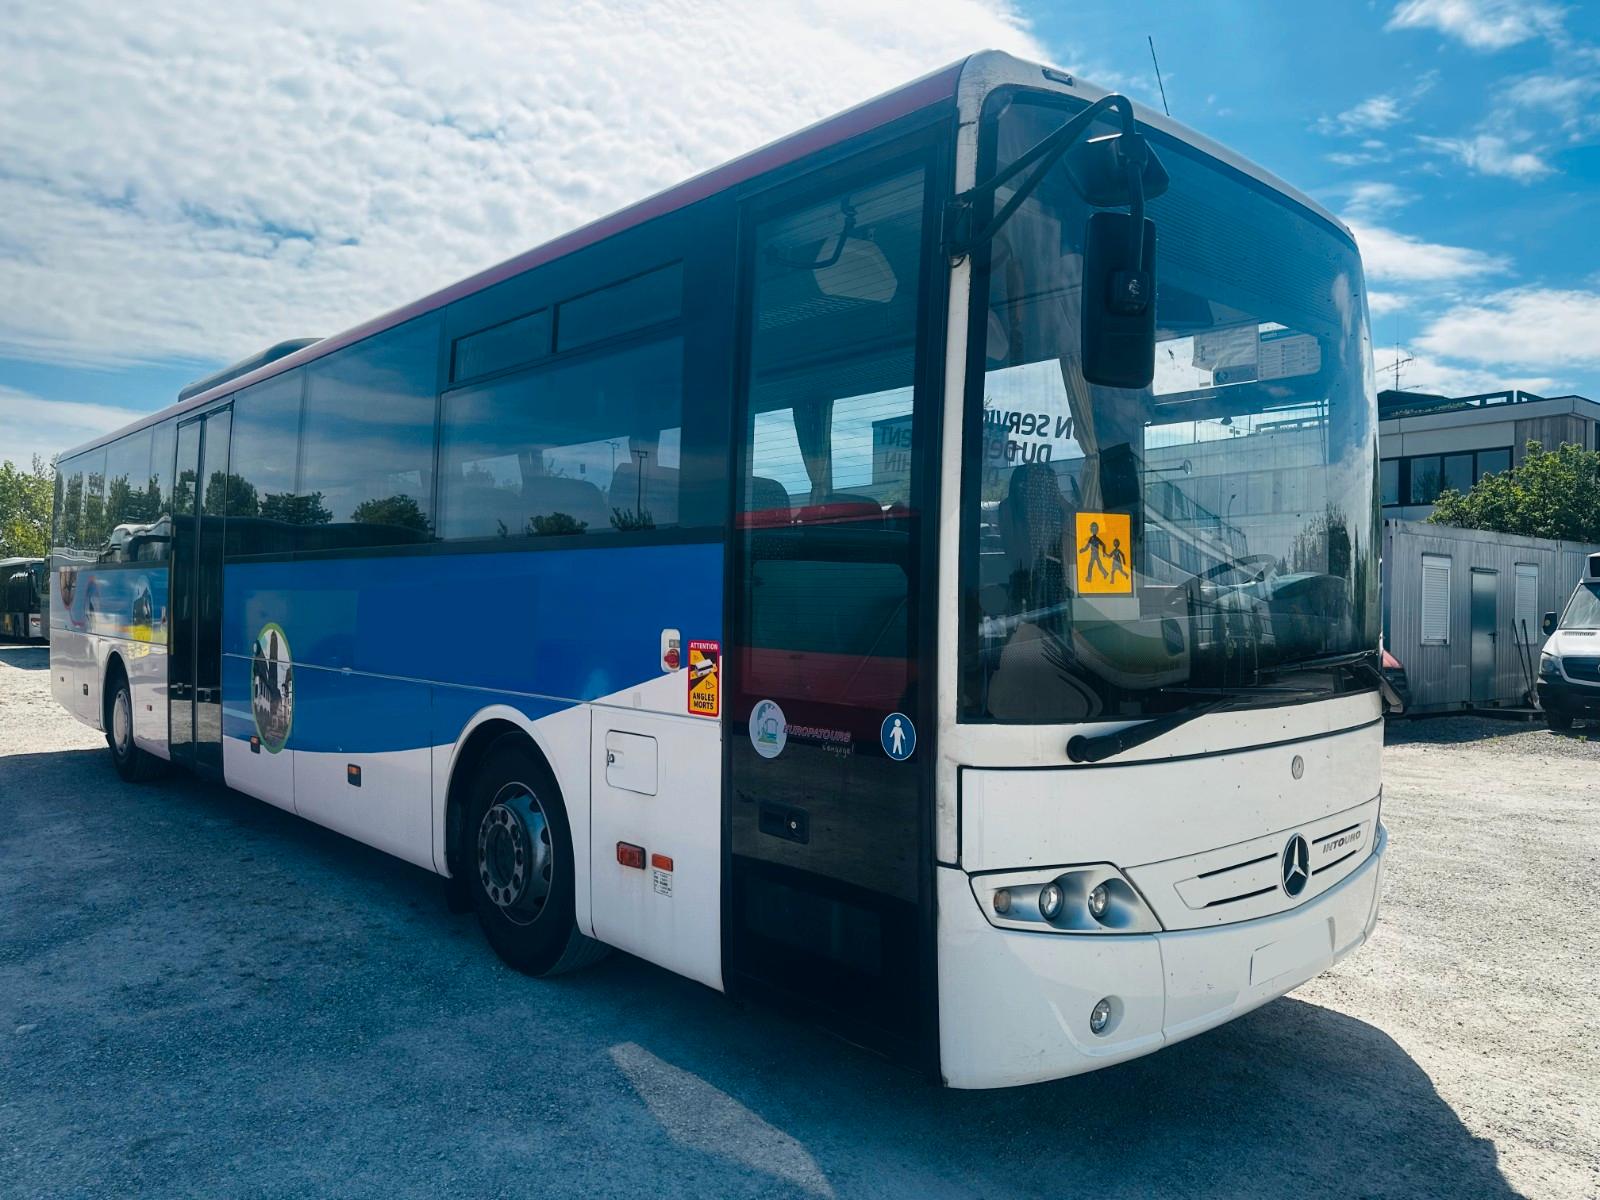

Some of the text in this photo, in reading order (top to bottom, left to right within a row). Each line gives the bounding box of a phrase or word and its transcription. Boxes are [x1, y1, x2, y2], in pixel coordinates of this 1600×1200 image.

[690, 642, 718, 650] ATTENTION
[692, 692, 715, 702] ANGLES
[693, 701, 714, 710] MORTS
[783, 724, 852, 743] EUROPATOURS
[1323, 830, 1361, 854] INTOURO
